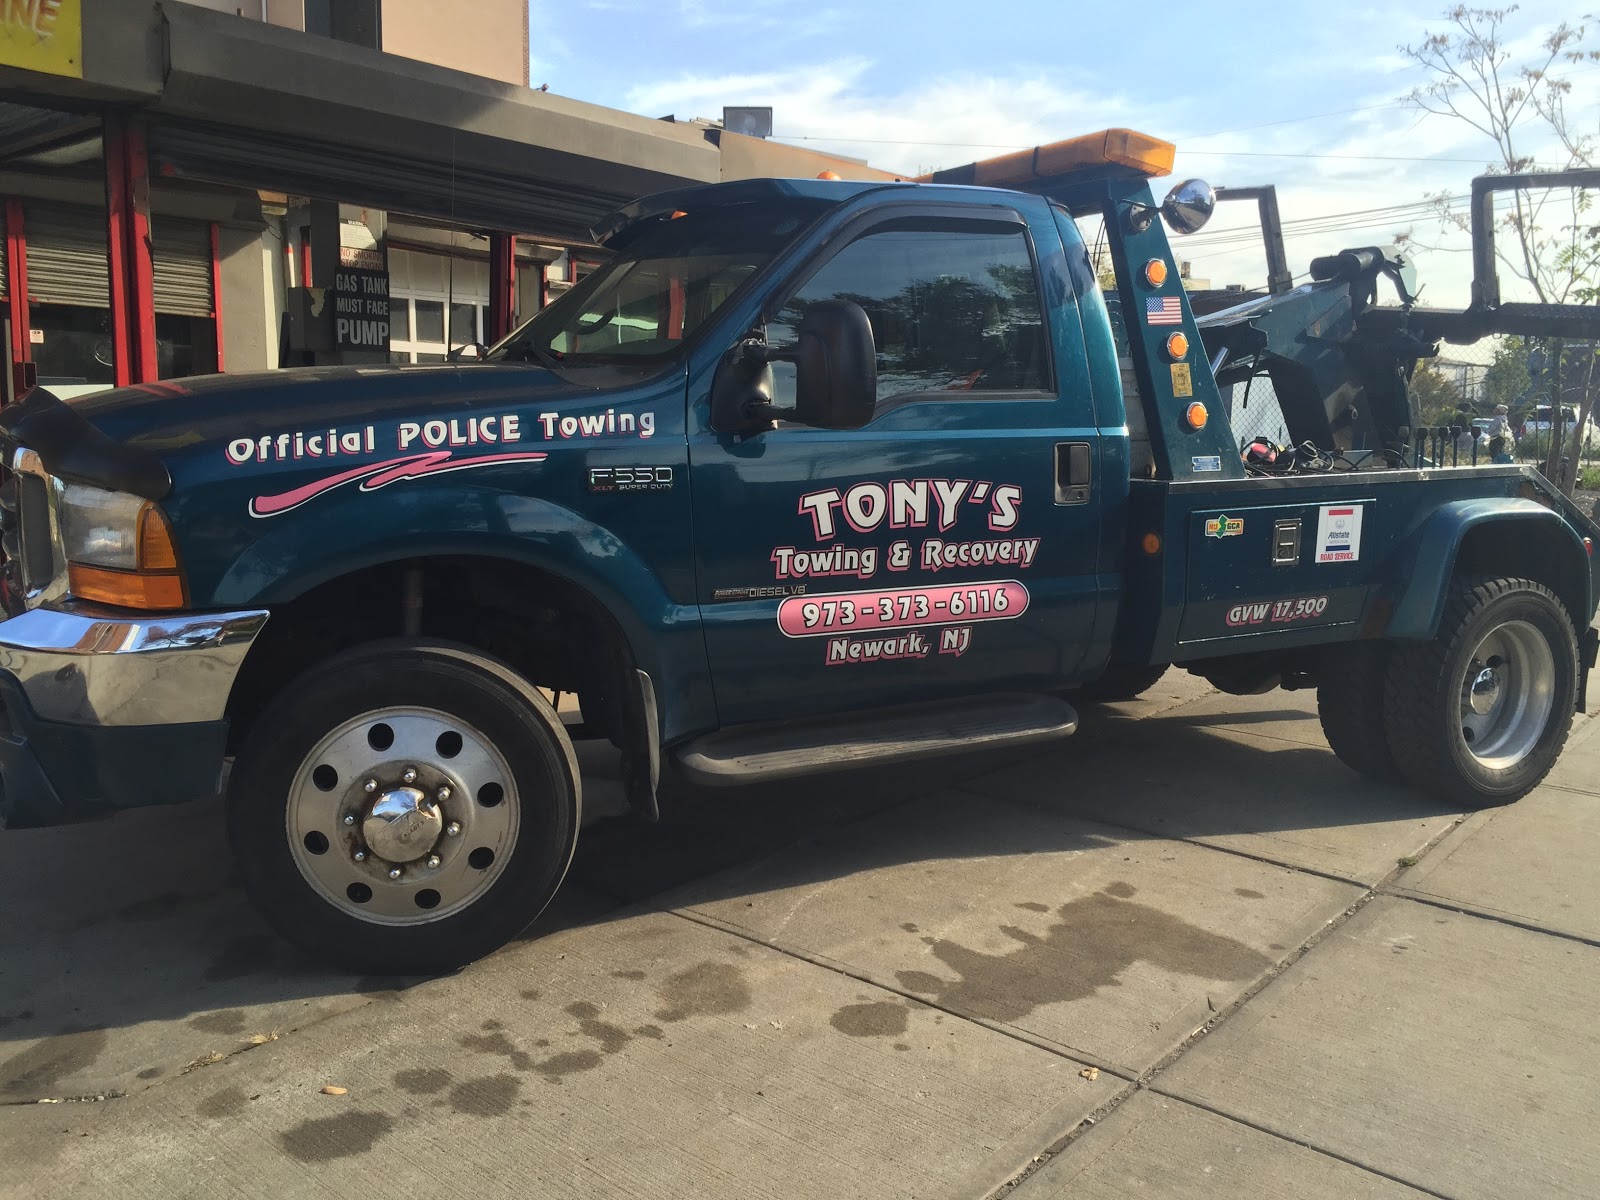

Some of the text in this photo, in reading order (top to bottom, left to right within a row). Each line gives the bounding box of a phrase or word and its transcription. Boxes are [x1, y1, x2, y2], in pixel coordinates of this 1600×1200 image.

[340, 248, 351, 258] NO
[340, 258, 359, 268] STOP
[336, 273, 387, 295] GAS TANK
[337, 297, 388, 316] MUST FACE
[337, 318, 389, 346] PUMP
[225, 408, 656, 465] Official POLICE Towing
[798, 478, 1022, 541] TONY'S
[1226, 522, 1241, 530] GCA
[1328, 531, 1350, 540] Allstate
[770, 537, 1041, 579] Towing & Recovery
[1320, 551, 1354, 561] ROAD SERVICE
[749, 585, 789, 598] DIESEL
[791, 584, 806, 595] V8
[801, 587, 1010, 629] 973-373-6116
[1226, 596, 1329, 627] GVW 17,500
[825, 626, 972, 666] Newark, NJ
